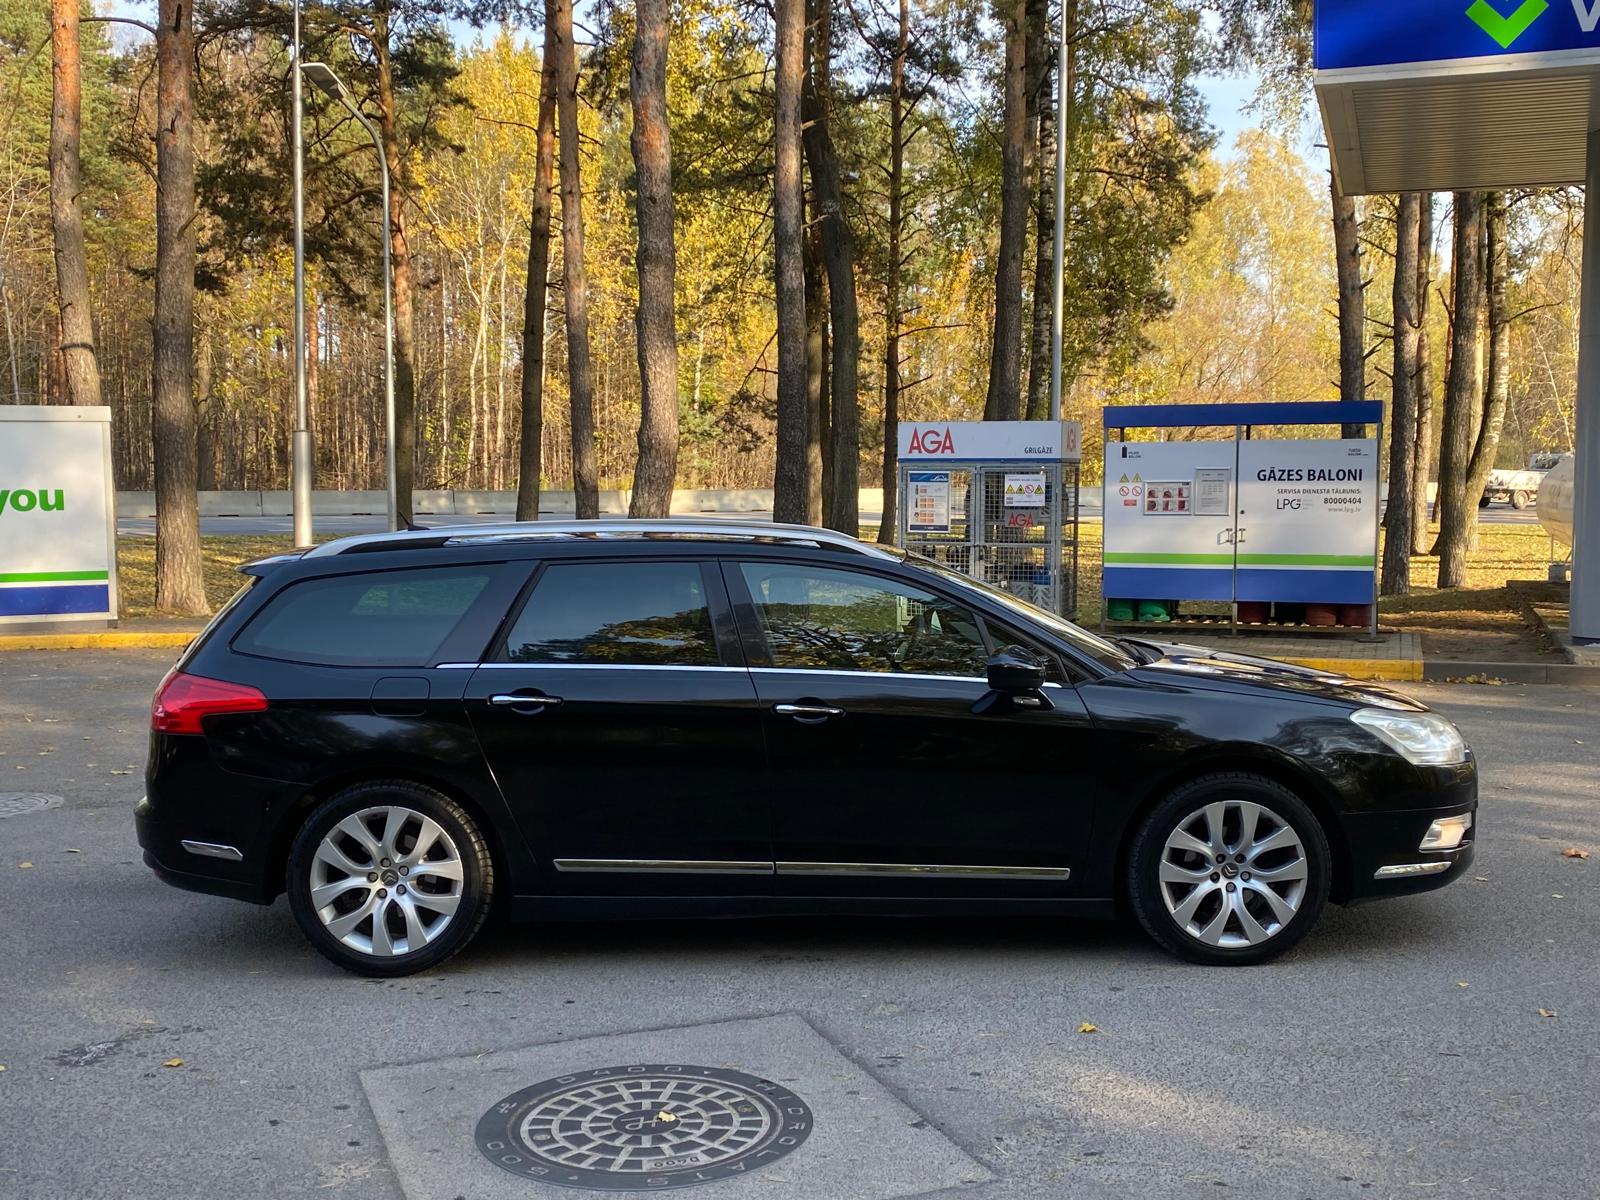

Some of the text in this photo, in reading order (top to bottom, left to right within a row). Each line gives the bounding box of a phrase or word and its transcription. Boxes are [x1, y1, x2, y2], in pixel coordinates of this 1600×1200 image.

[908, 427, 954, 454] AGA
[1257, 466, 1363, 482] GĀZES BALONI
[1276, 498, 1301, 510] LPG
[1323, 497, 1362, 505] 80000404
[1008, 512, 1034, 528] AGA
